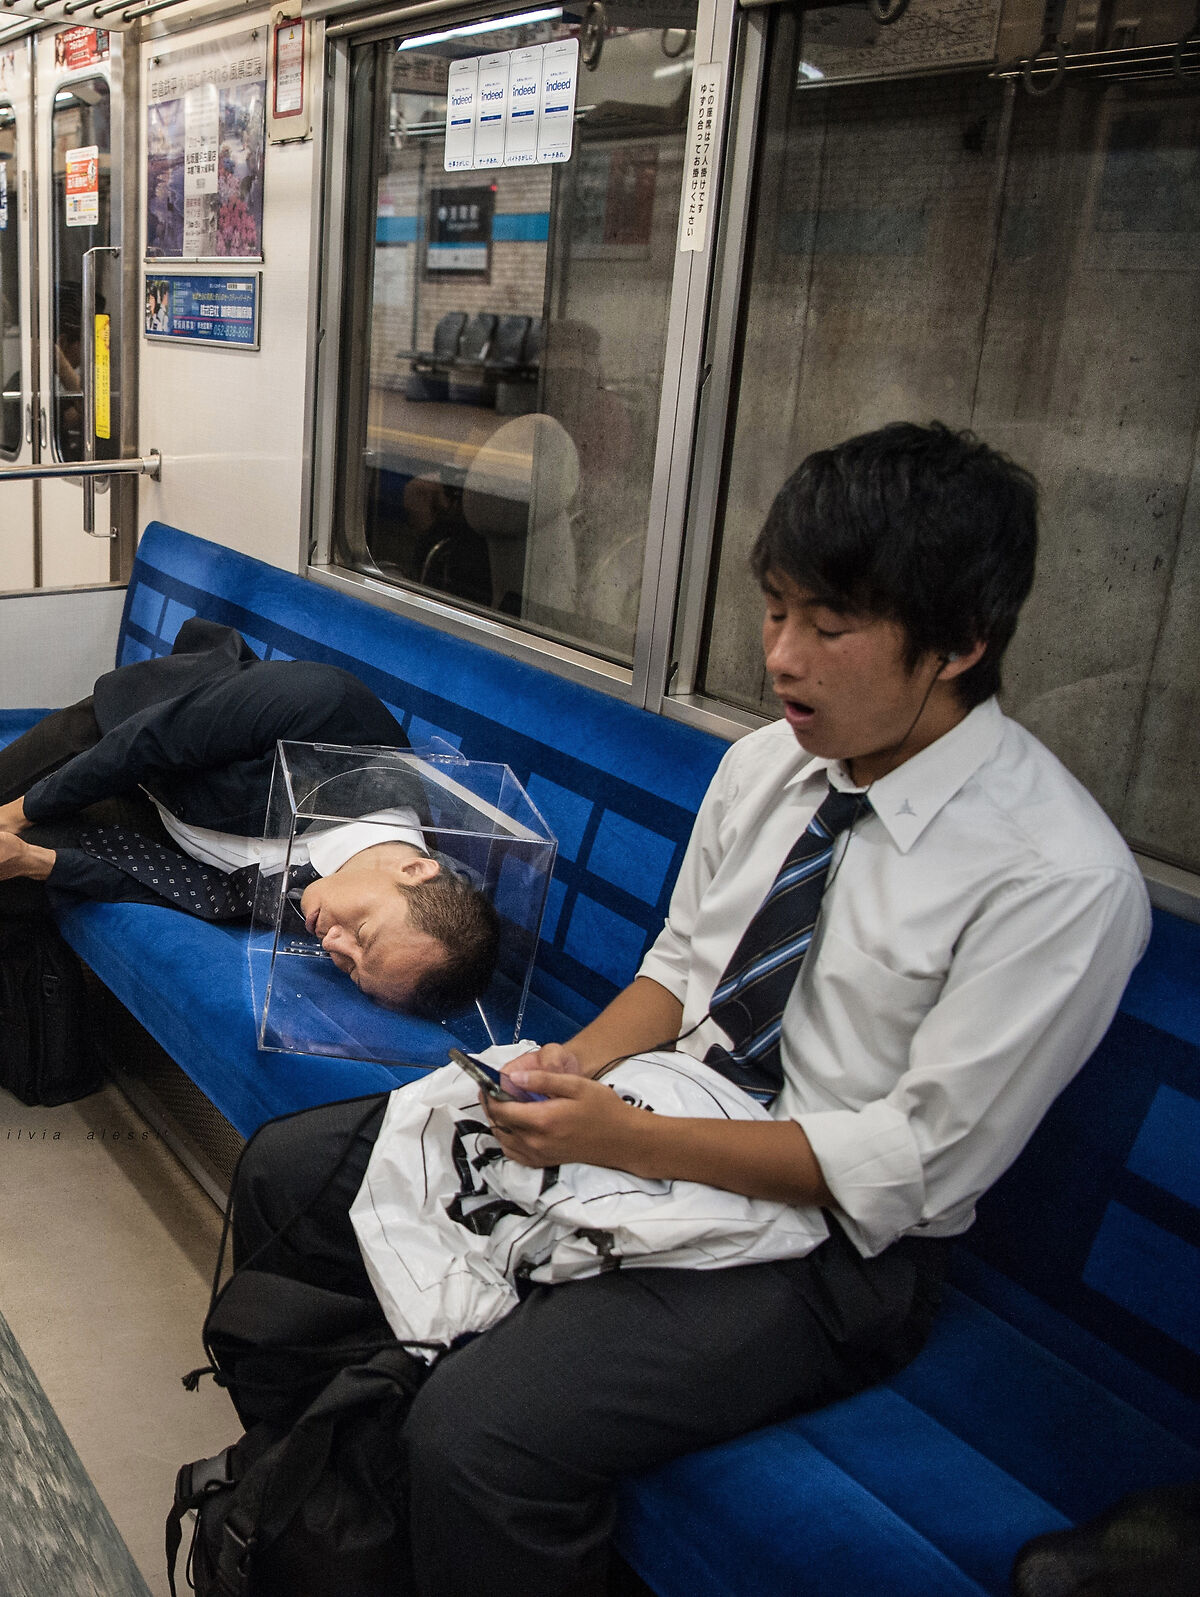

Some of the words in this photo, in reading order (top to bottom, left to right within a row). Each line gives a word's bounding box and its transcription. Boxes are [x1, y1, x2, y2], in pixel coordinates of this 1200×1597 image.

[512, 83, 537, 97] indeed
[545, 78, 571, 92] indeed
[451, 94, 473, 106] indeed
[481, 89, 504, 101] indeed
[686, 83, 708, 237] ゆずり合ってお掛けください
